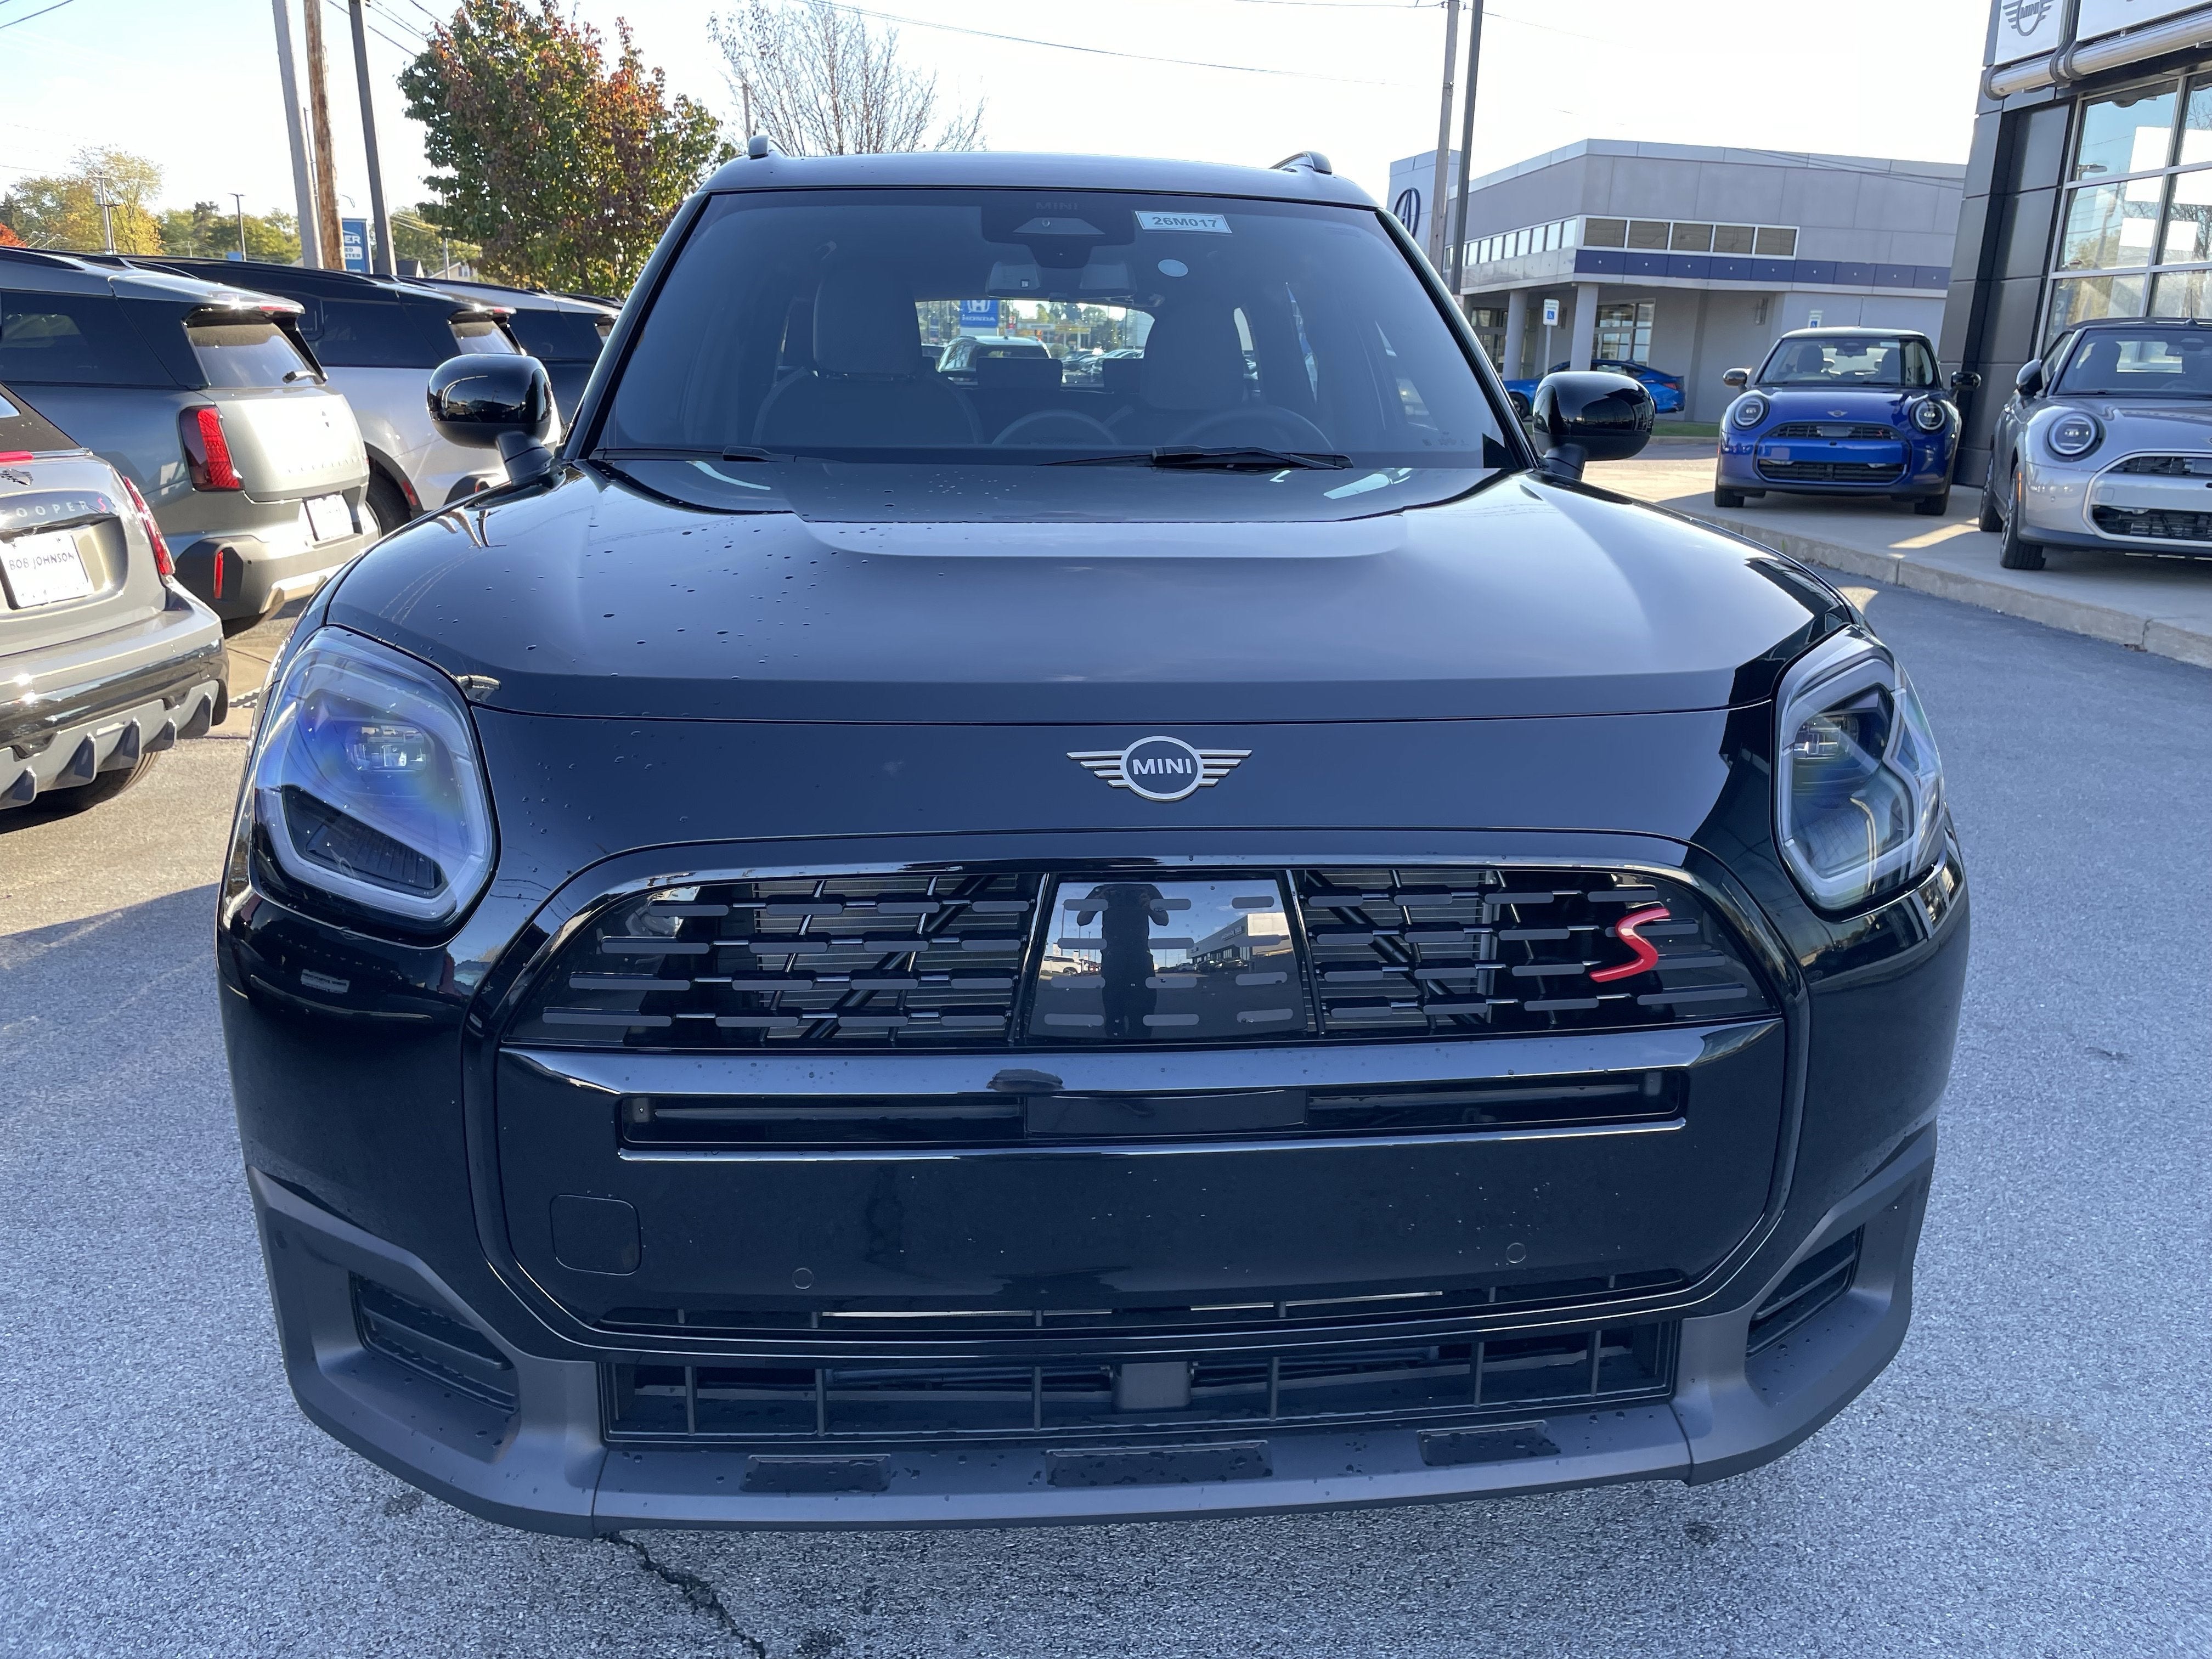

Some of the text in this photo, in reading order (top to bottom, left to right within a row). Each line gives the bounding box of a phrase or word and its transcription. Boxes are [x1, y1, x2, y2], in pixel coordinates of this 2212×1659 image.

[2019, 2, 2040, 19] MINI
[1036, 202, 1077, 210] MINI
[1152, 217, 1217, 228] 26M017
[97, 496, 107, 512] S
[9, 552, 75, 570] BOB JOHNSON
[1132, 758, 1192, 775] MINI
[1589, 907, 1671, 983] S
